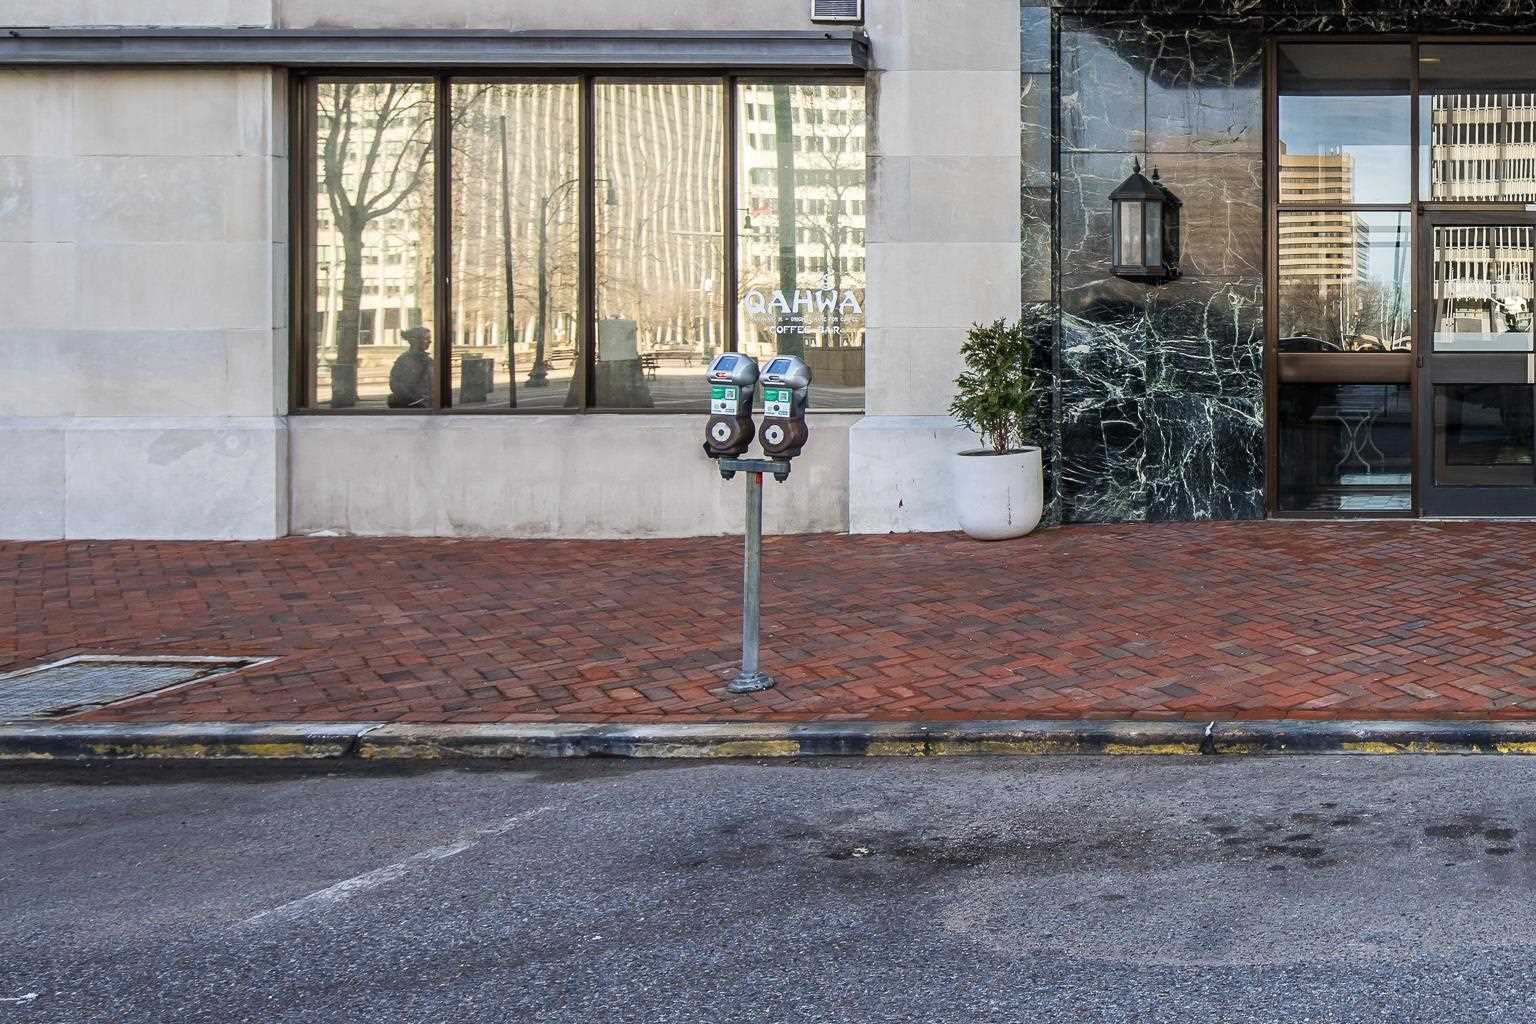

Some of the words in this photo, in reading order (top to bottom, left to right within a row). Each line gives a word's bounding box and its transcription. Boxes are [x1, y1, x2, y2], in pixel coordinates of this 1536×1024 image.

[744, 289, 863, 314] QAHWA
[769, 325, 812, 335] COFFEE
[818, 325, 840, 335] BAR
